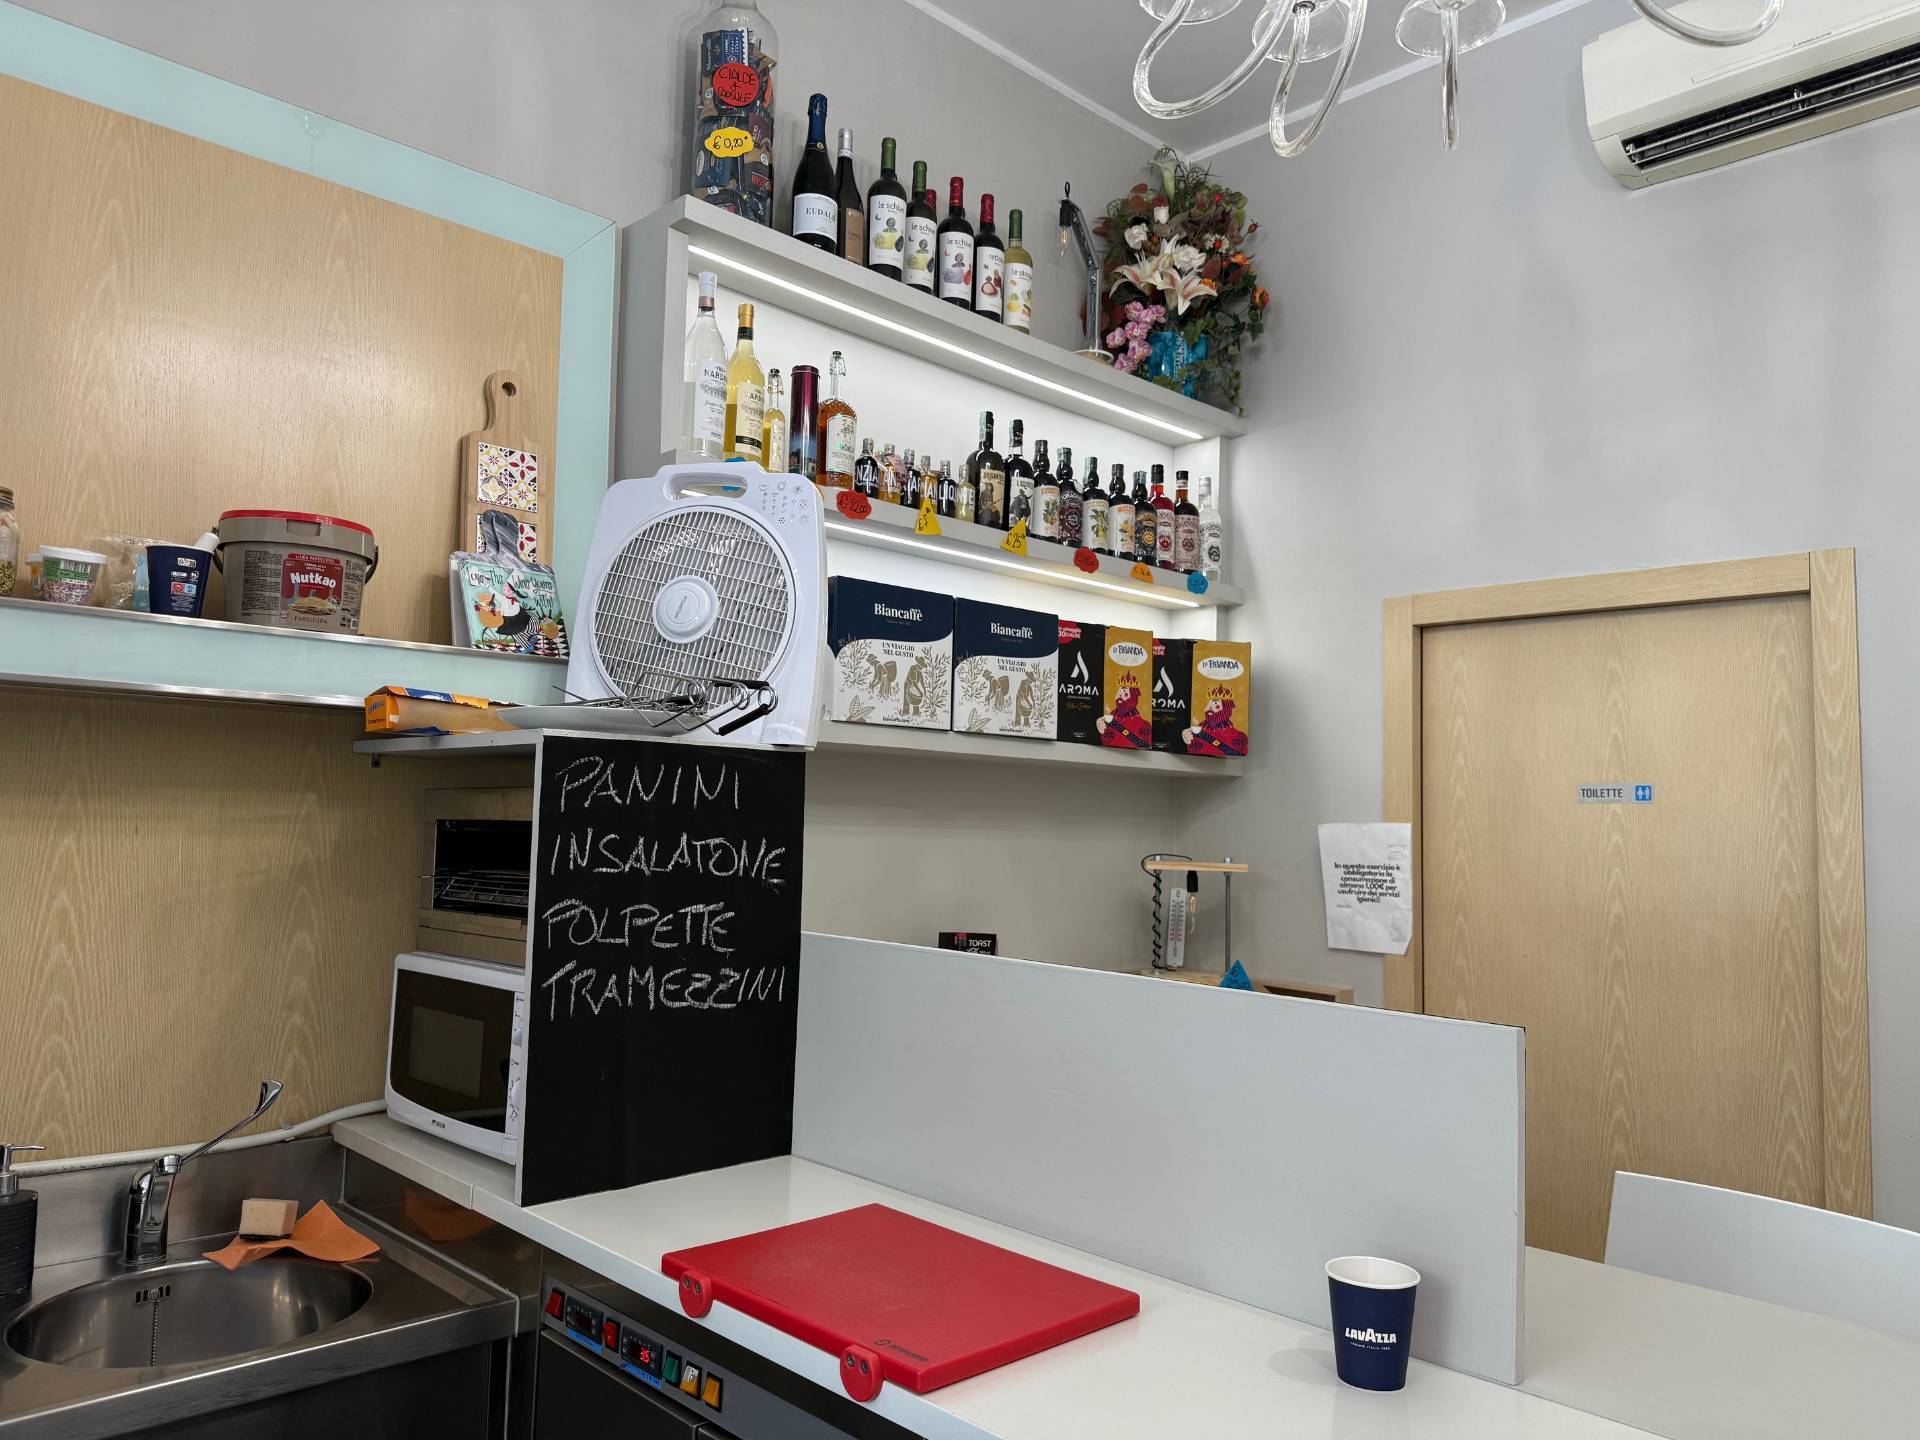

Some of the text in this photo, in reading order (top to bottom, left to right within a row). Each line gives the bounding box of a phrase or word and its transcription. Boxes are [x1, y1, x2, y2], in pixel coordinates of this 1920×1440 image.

[290, 572, 337, 588] Nutkao
[874, 603, 923, 621] Biancaffè
[990, 622, 1033, 640] Biancaffè
[1058, 684, 1099, 697] AROMA
[555, 755, 740, 813] PANINI
[1580, 788, 1624, 799] TOILETTE
[550, 827, 786, 883] INSALATONE
[542, 898, 736, 952] POLPETTE
[968, 939, 992, 947] TOAST
[541, 959, 786, 1022] TRAMEZZINI
[1345, 1327, 1397, 1343] LAVAZZA
